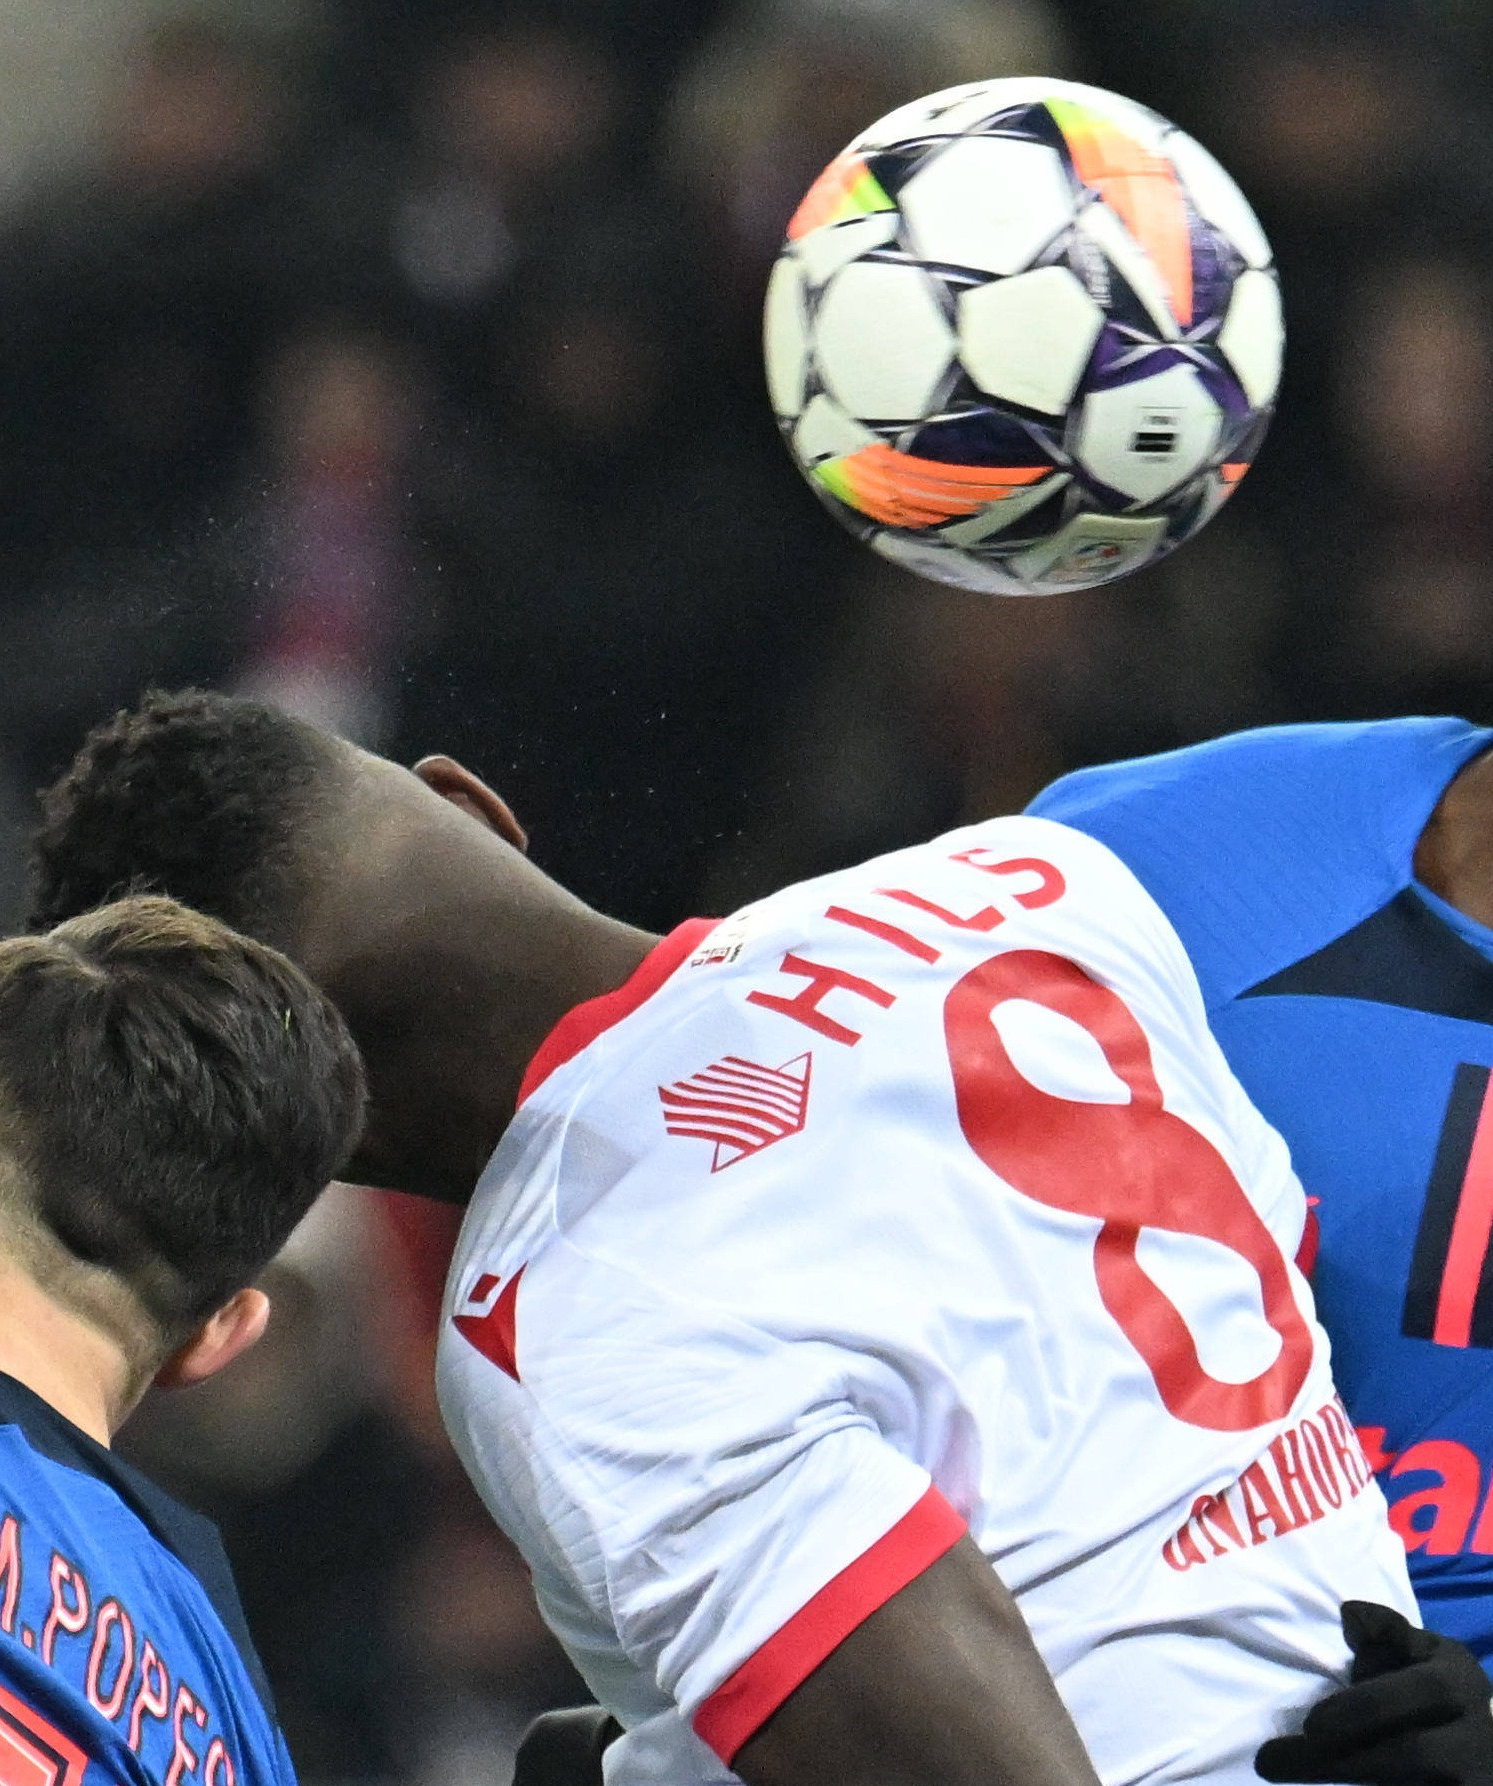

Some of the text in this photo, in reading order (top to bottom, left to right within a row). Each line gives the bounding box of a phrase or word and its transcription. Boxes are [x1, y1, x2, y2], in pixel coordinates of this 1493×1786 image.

[745, 848, 1065, 1047] HILS
[943, 949, 1314, 1432] 8
[1162, 1394, 1375, 1571] GNAHOR
